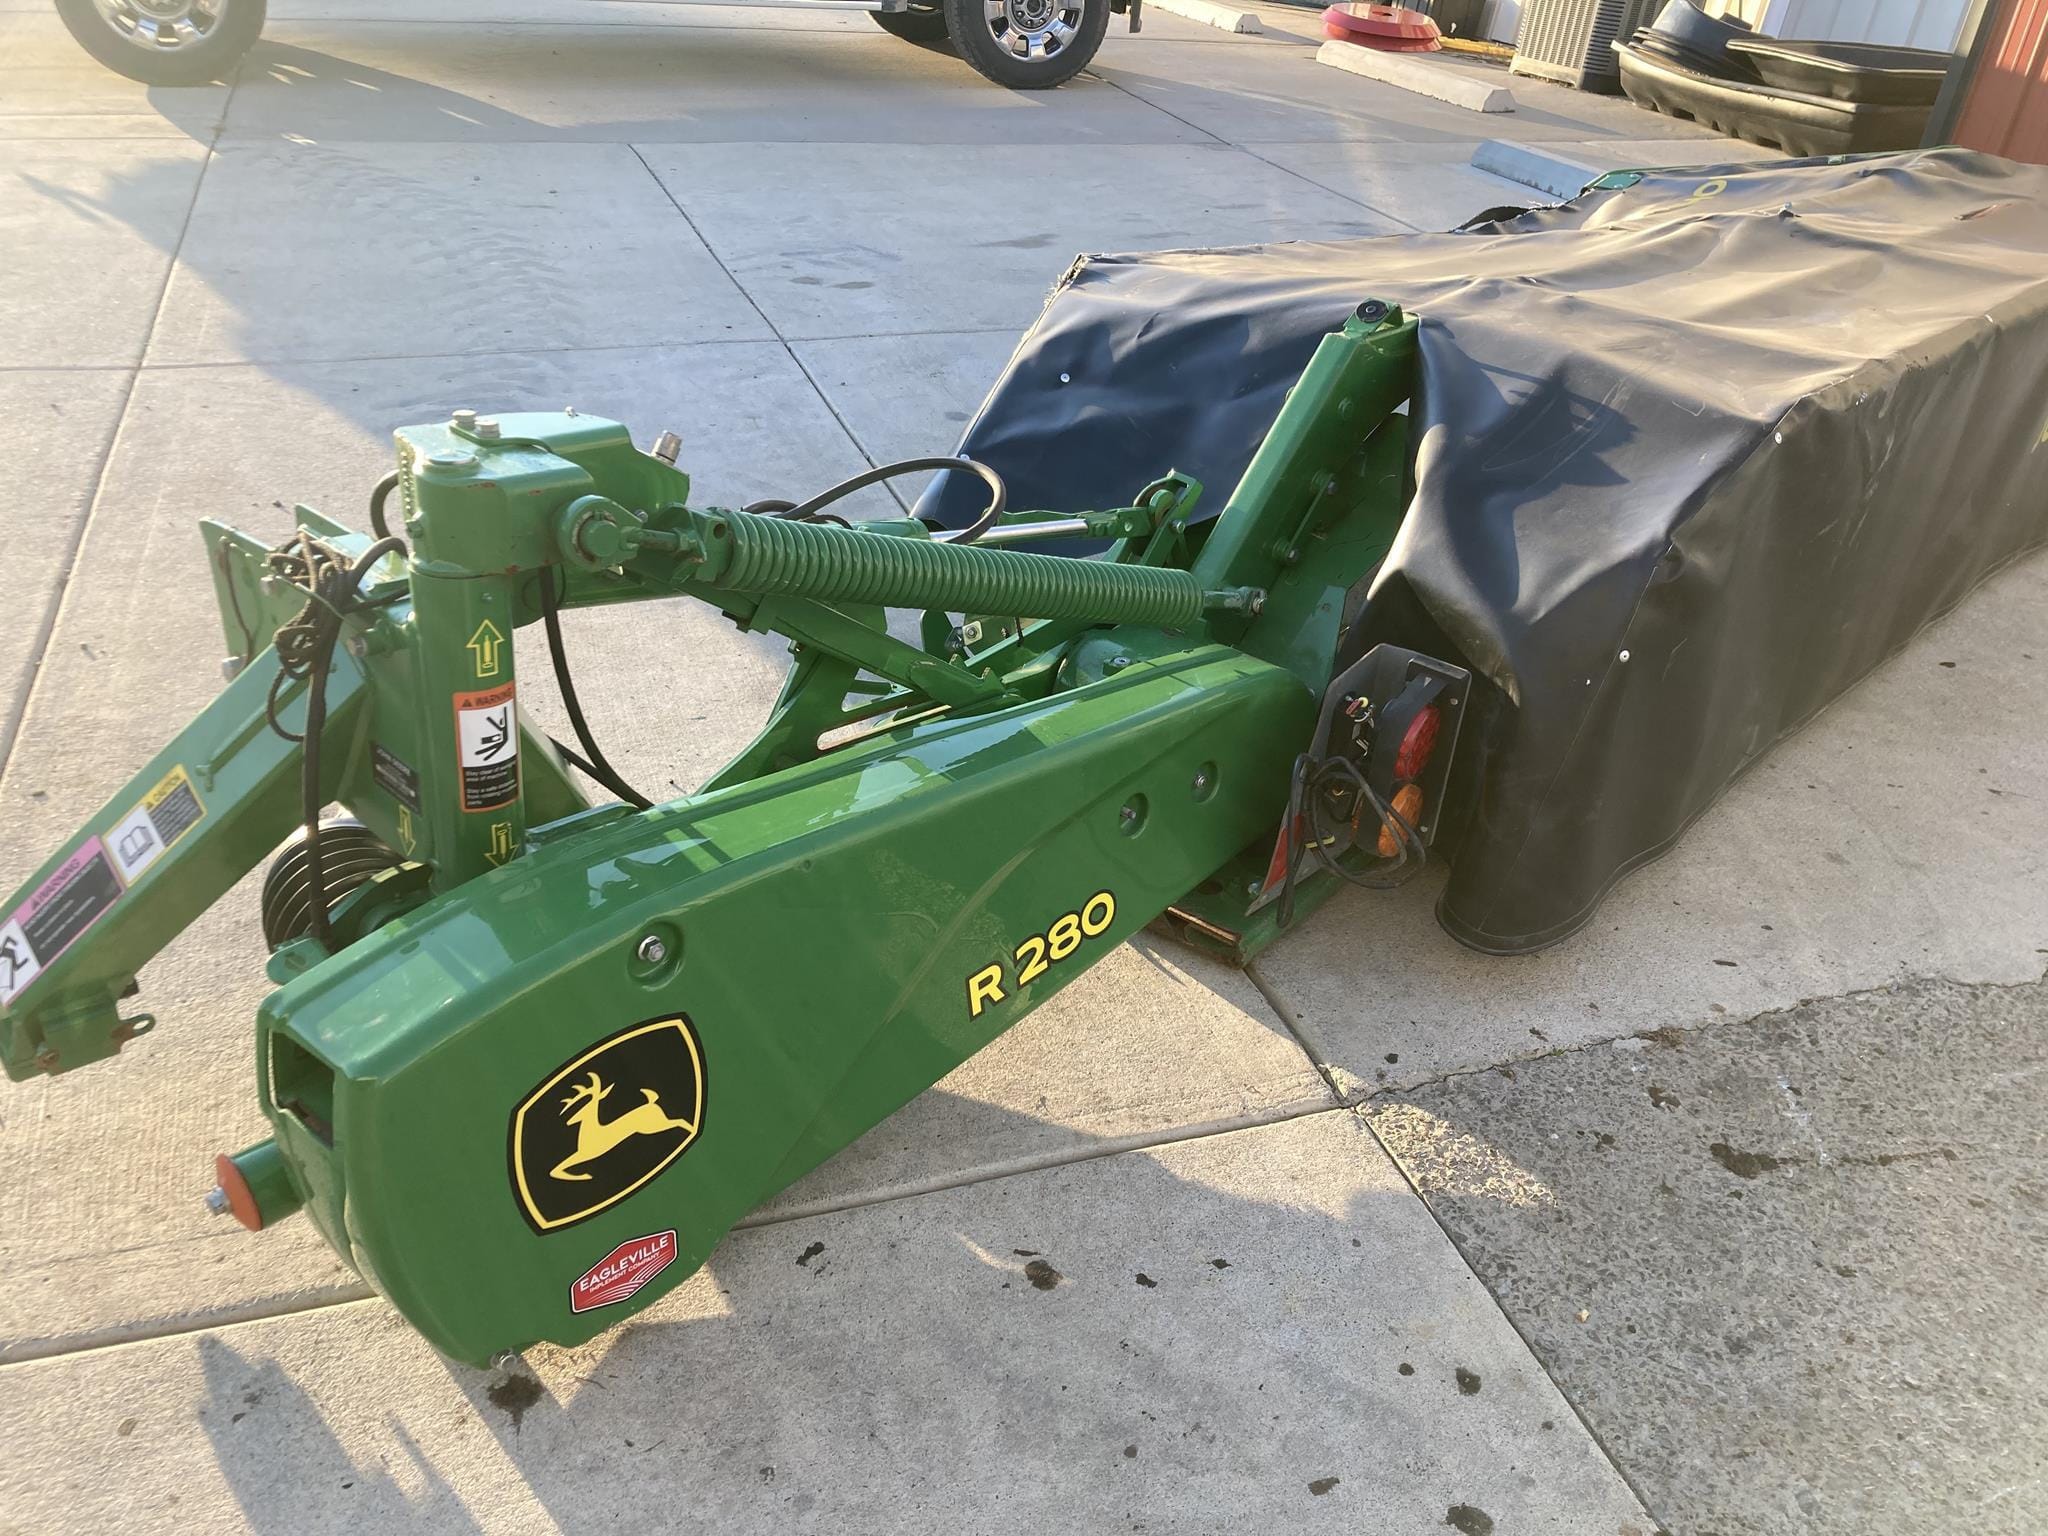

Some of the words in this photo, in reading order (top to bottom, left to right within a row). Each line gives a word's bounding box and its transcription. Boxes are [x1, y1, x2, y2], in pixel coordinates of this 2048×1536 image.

[967, 962, 1008, 1019] R
[1015, 891, 1116, 987] 280
[580, 1235, 668, 1292] EAGLEVILLE
[589, 1270, 627, 1293] IMPLEMENT
[628, 1252, 660, 1272] COMPANY
